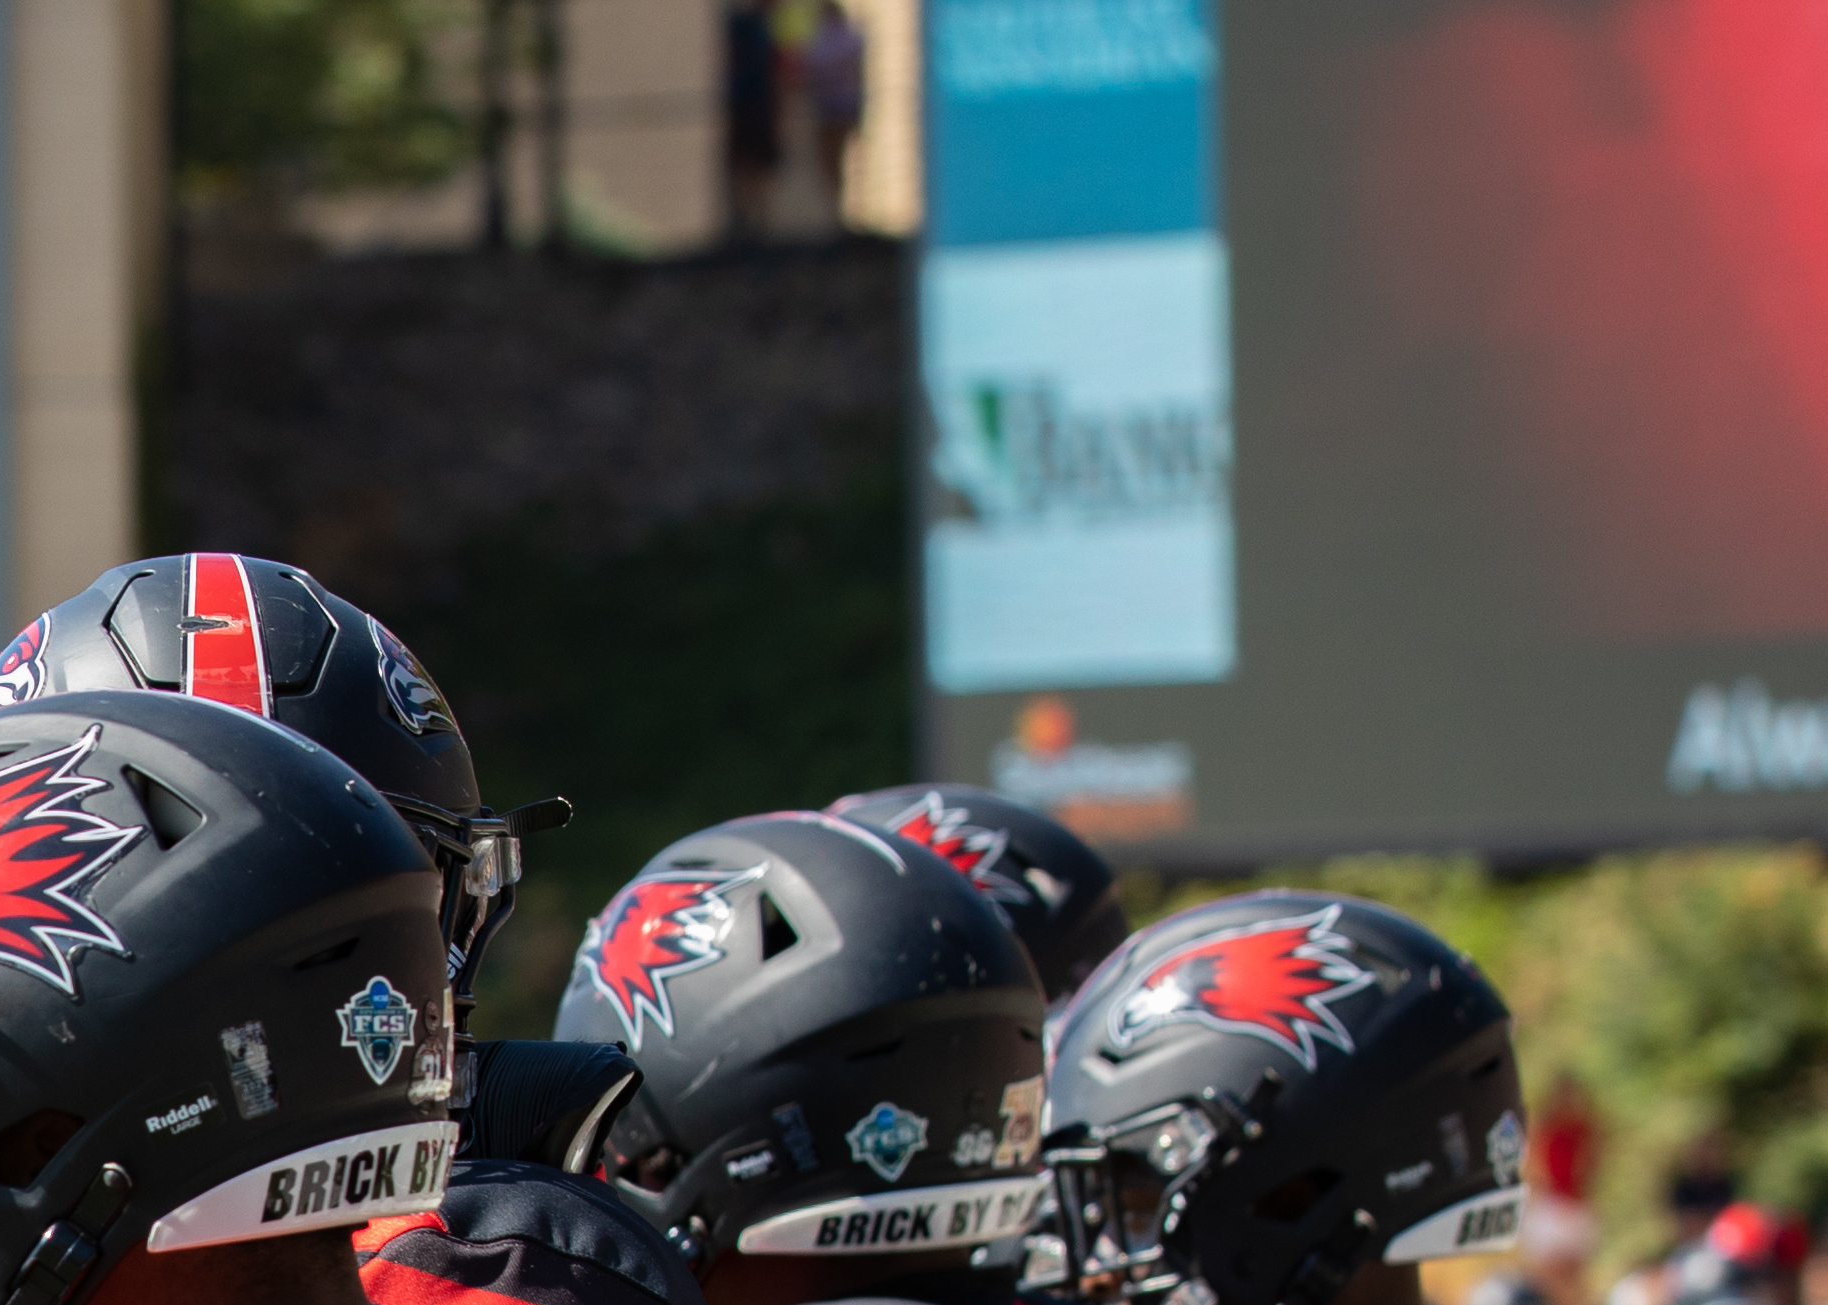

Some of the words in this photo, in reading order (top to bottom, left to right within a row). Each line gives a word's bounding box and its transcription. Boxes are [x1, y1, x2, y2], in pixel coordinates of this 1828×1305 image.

[354, 1015, 405, 1033] FCS
[145, 1095, 213, 1133] Riddell
[261, 1143, 402, 1223] BRICK
[408, 1140, 446, 1196] BY
[816, 1206, 936, 1247] BRICK
